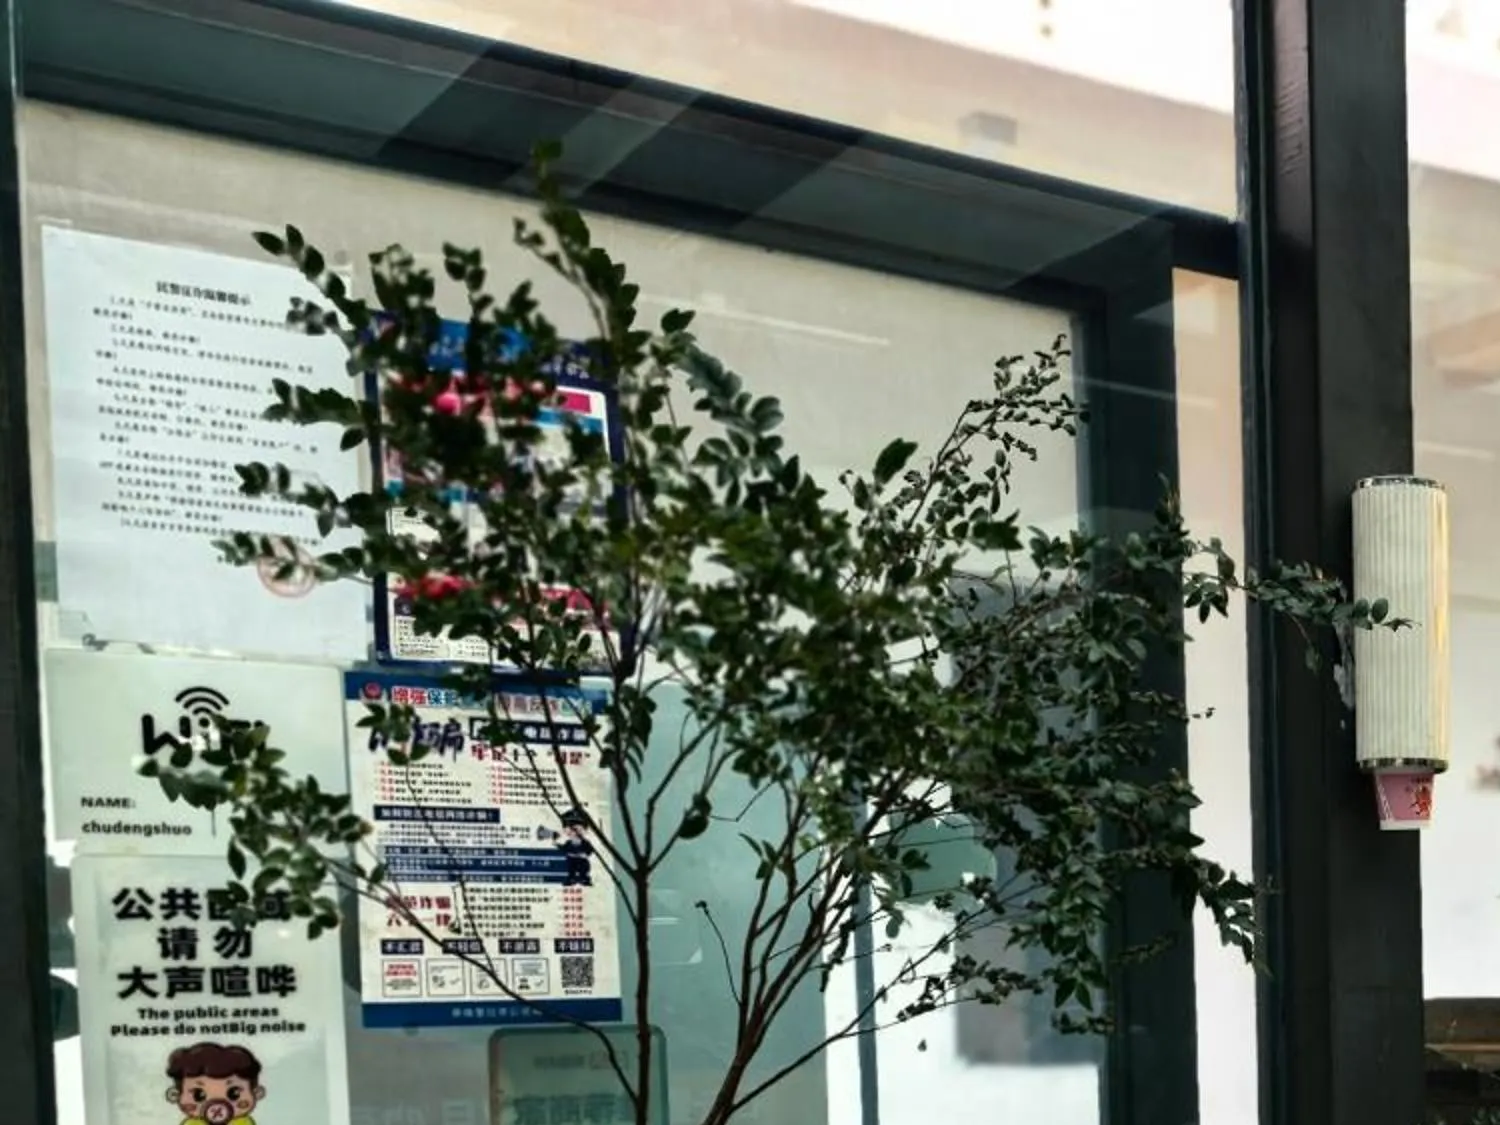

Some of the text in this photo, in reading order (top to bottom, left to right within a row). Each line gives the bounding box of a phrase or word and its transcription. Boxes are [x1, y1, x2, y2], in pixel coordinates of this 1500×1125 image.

[81, 797, 136, 809] NAME:
[81, 821, 192, 837] chudengshuo
[157, 926, 254, 961] 请勿
[117, 964, 297, 999] 大声喧哗
[138, 1006, 279, 1021] The public areas
[111, 1023, 170, 1037] Please
[174, 1022, 196, 1036] do
[260, 1020, 306, 1033] noise
